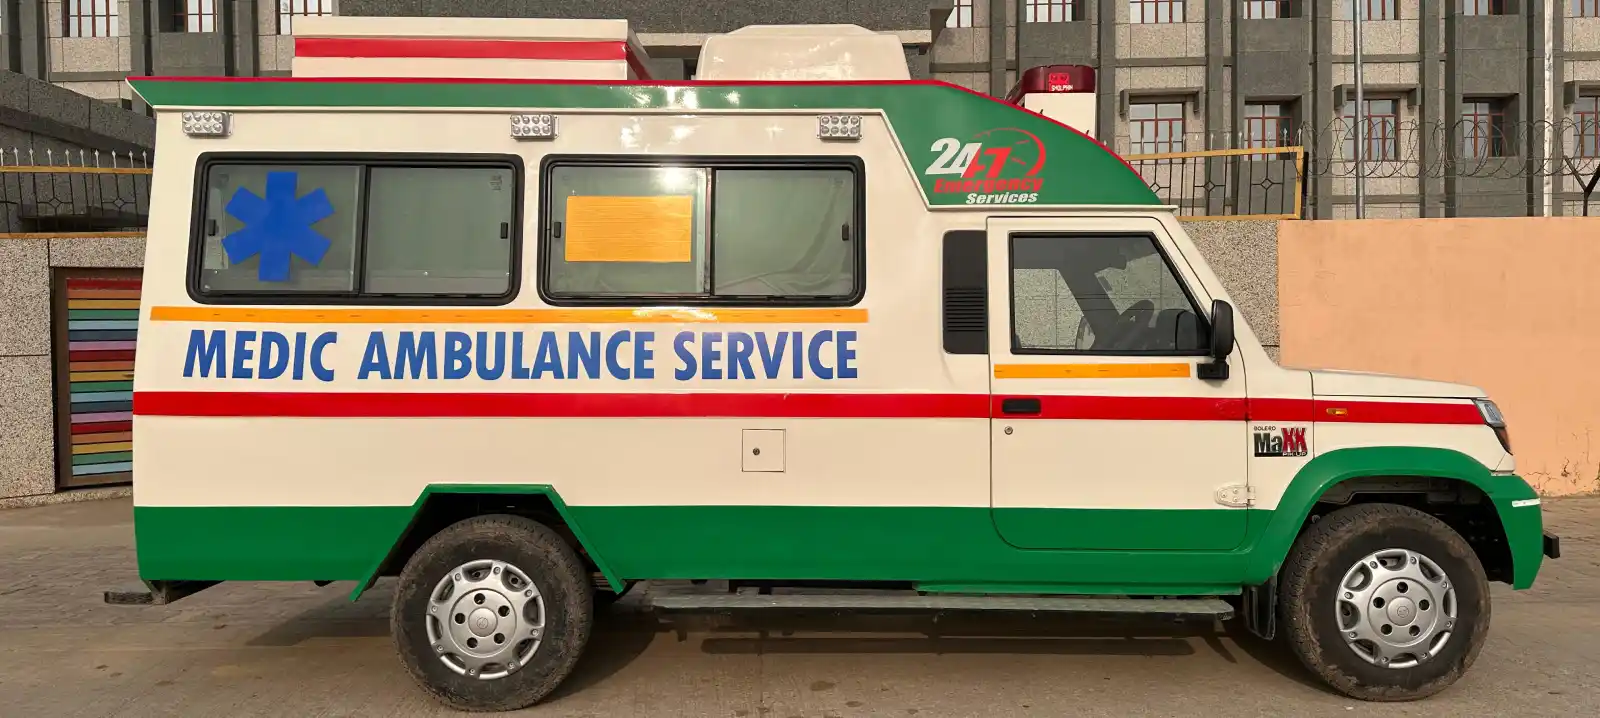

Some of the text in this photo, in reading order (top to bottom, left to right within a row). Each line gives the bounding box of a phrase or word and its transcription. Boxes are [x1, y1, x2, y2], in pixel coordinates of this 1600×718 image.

[933, 178, 1044, 193] Emergency
[965, 192, 1039, 205] Services
[183, 329, 858, 382] MEDIC AMBULANCE SERVICE
